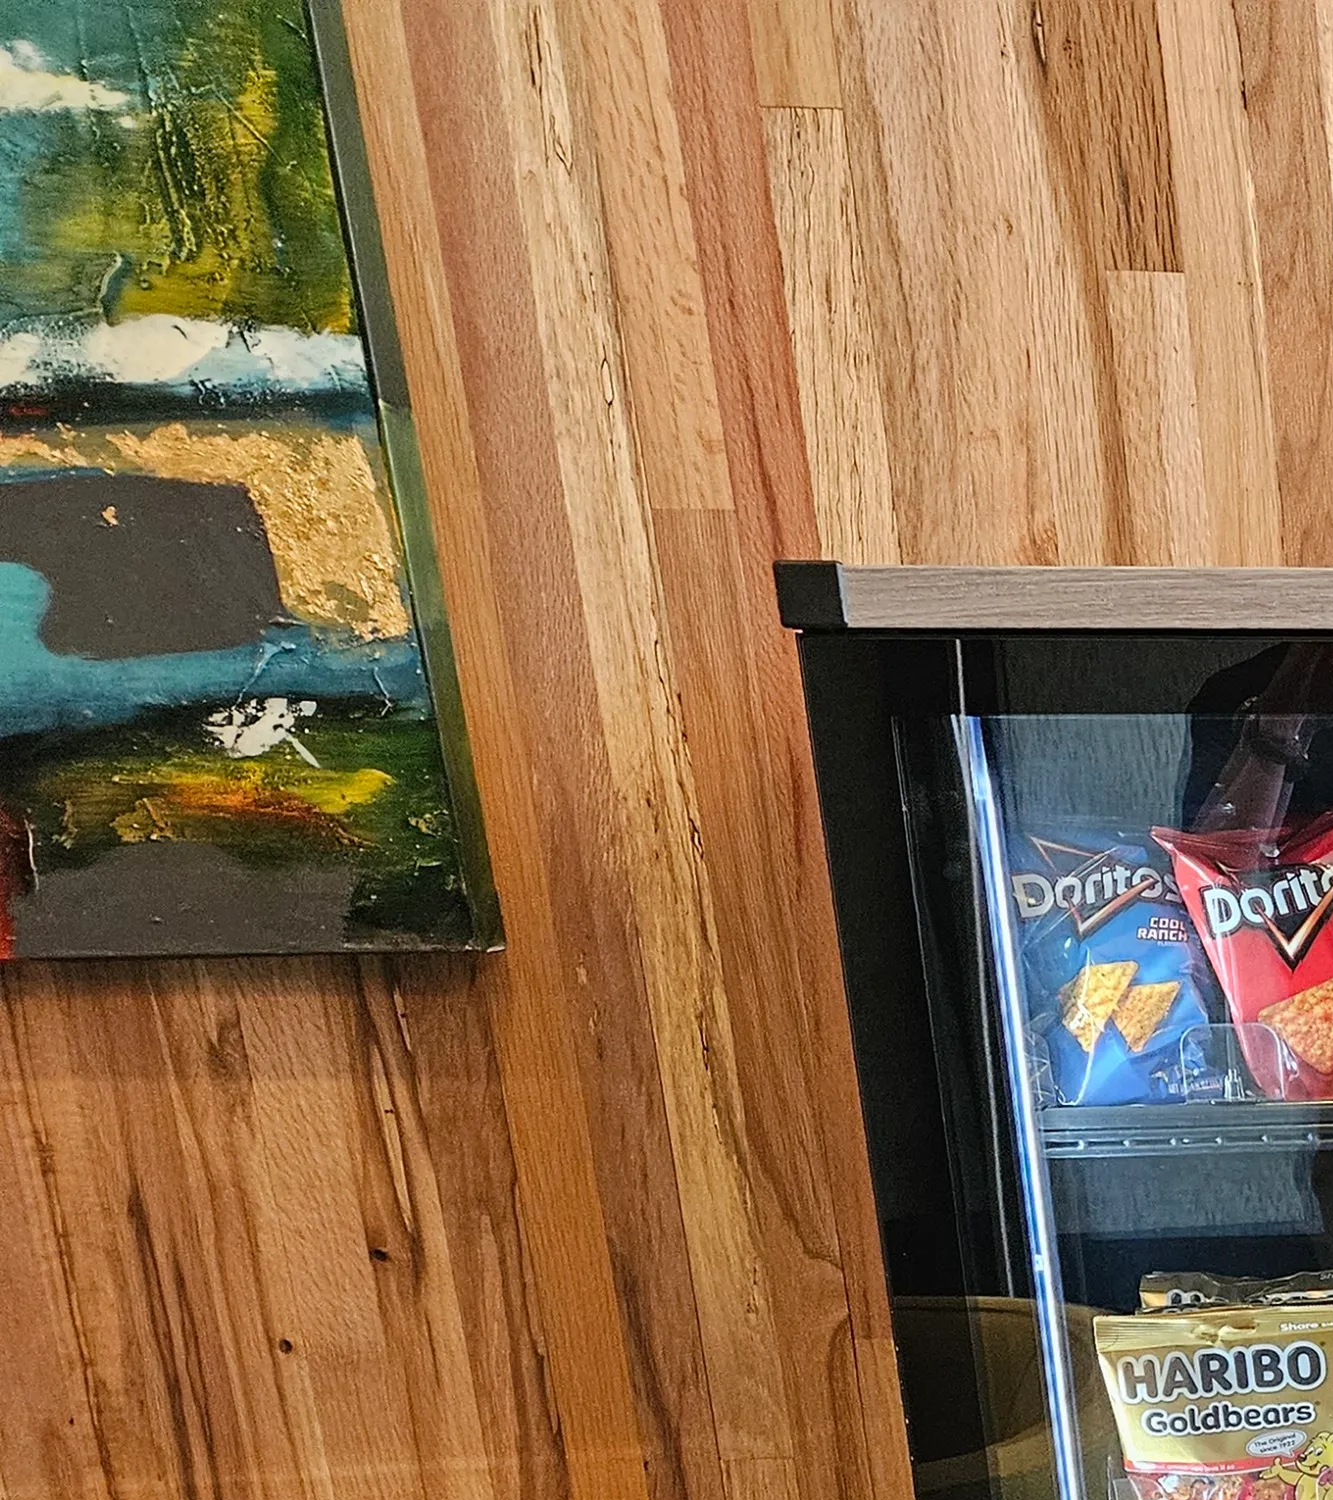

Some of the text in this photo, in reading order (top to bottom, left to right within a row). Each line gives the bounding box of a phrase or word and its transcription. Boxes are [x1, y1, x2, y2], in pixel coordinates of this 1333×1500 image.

[1149, 918, 1186, 930] COOL
[1137, 928, 1188, 942] RANCH
[1279, 1322, 1319, 1333] Share
[1120, 1343, 1325, 1403] HARIBO
[1142, 1402, 1315, 1435] Goldbears
[1269, 1433, 1296, 1445] Original
